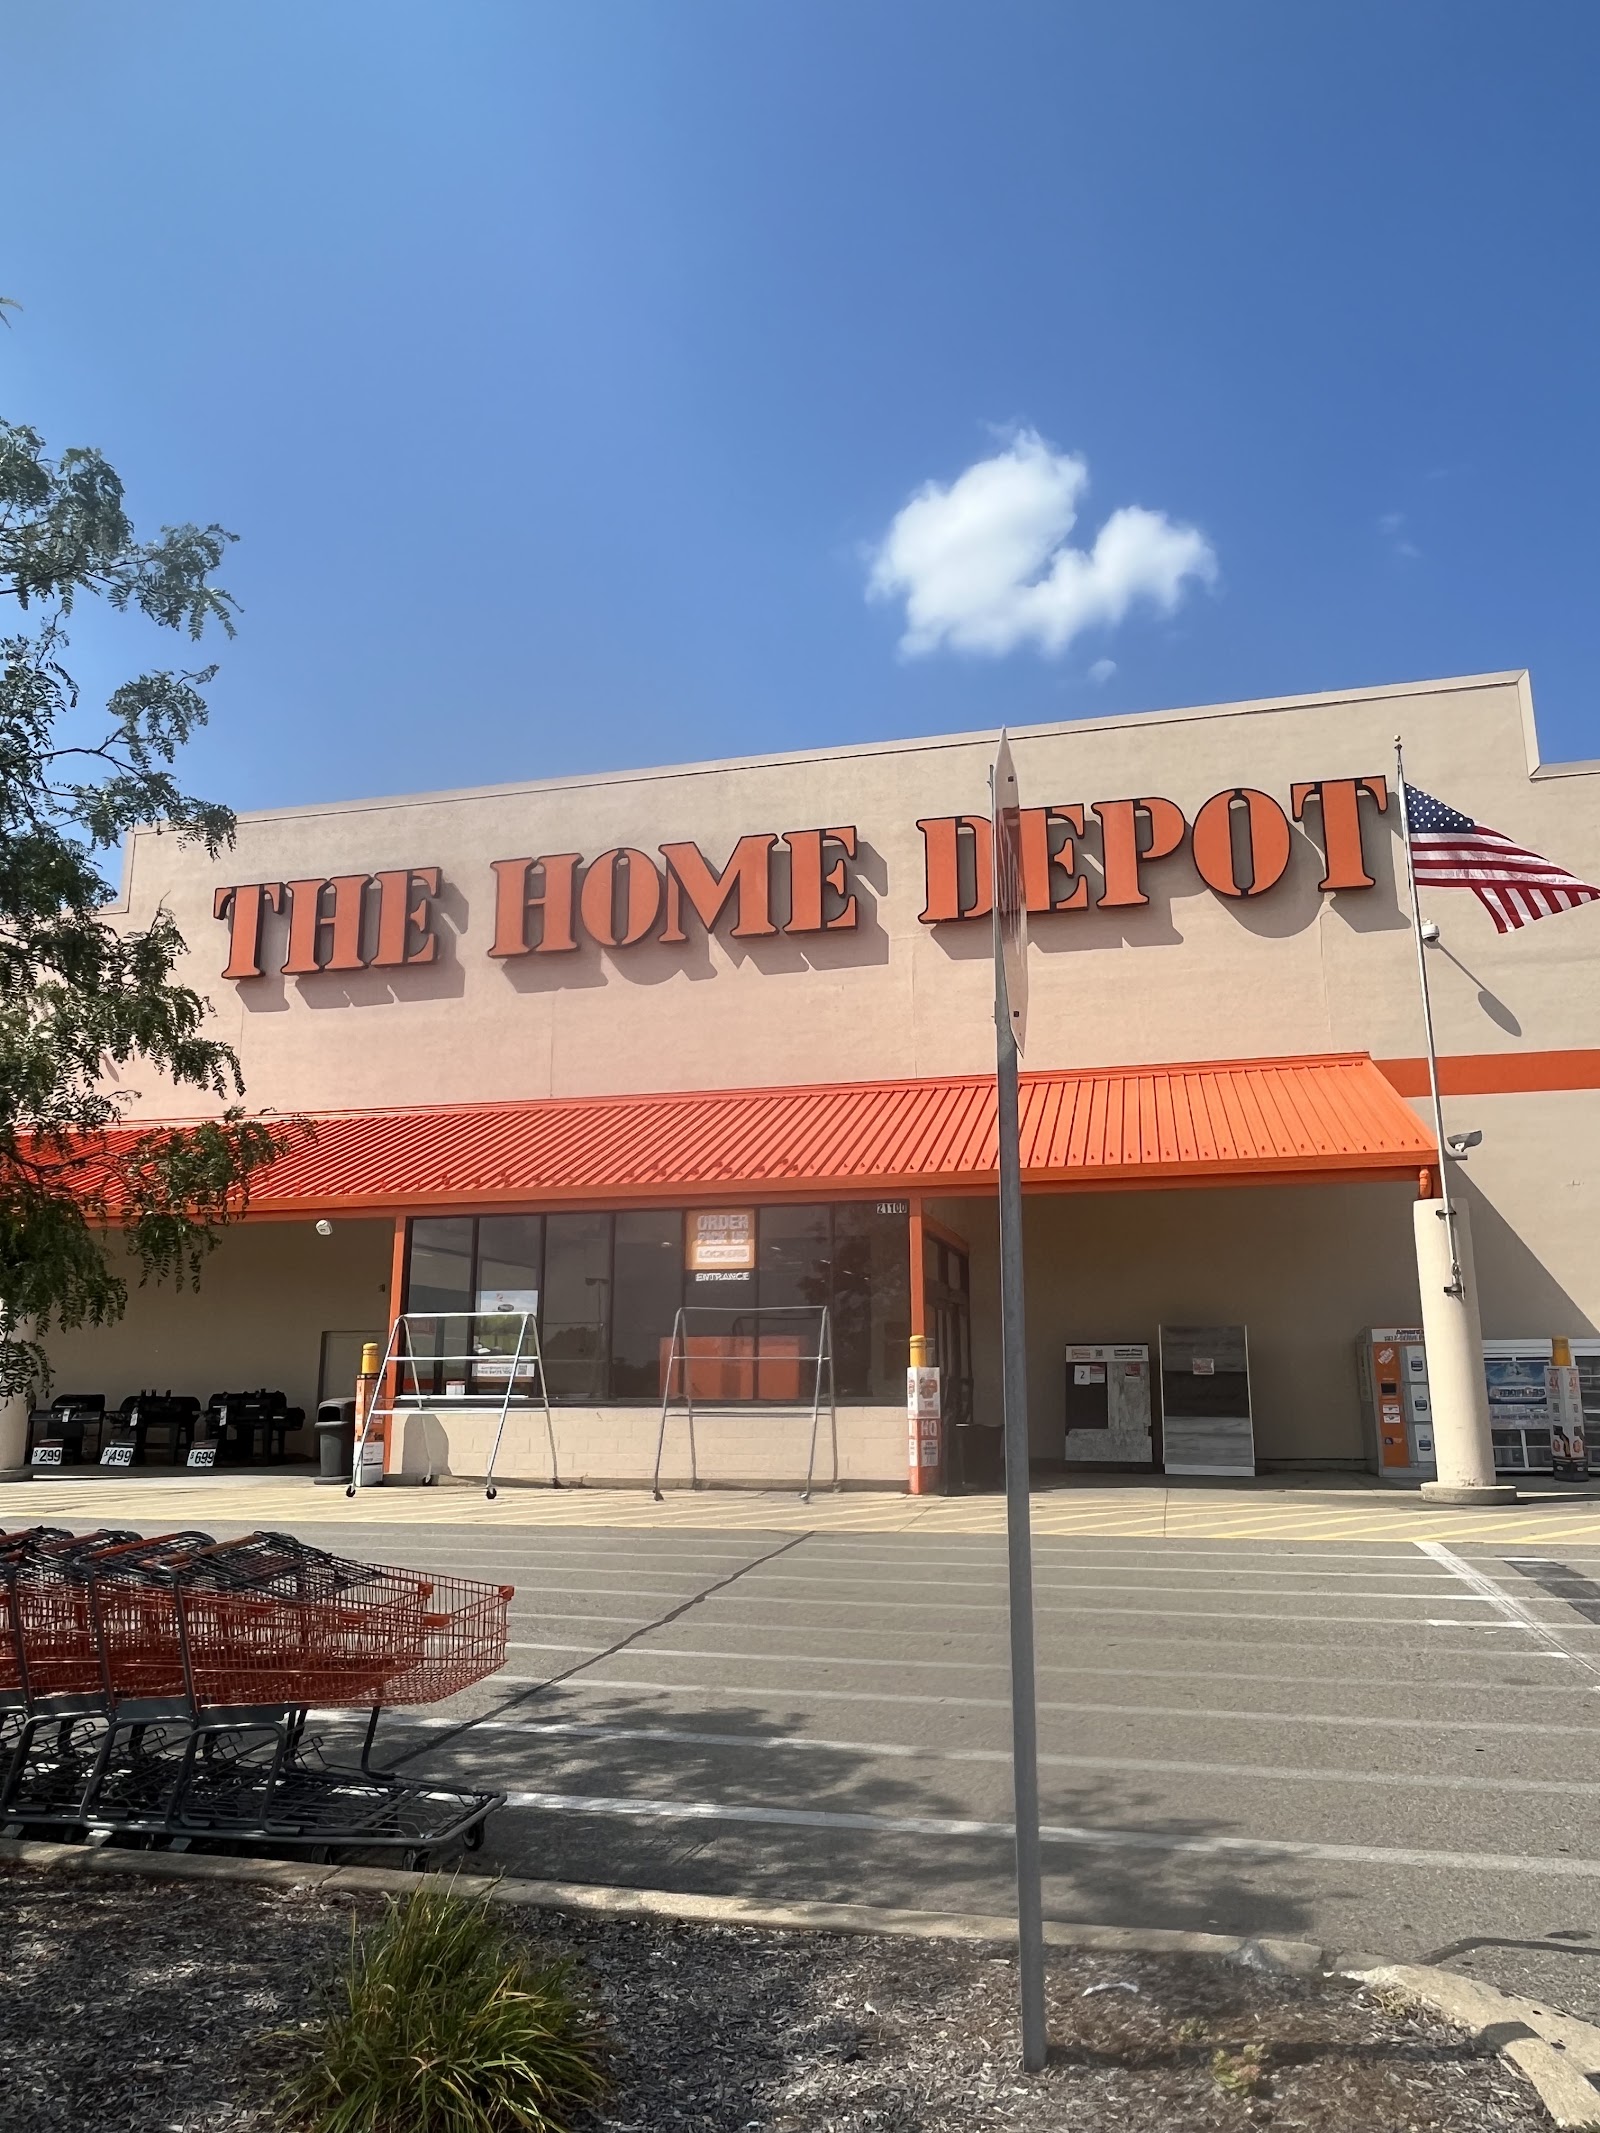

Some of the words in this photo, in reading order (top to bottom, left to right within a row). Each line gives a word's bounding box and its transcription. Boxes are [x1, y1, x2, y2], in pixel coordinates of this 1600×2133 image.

[213, 867, 443, 980] THE
[488, 826, 859, 959] HOME
[915, 775, 1388, 924] DEPOT
[697, 1214, 748, 1231] ORDER
[695, 1272, 750, 1282] ENTRANCE
[33, 1449, 61, 1463] $299
[103, 1447, 132, 1463] $499
[189, 1450, 215, 1465] $699
